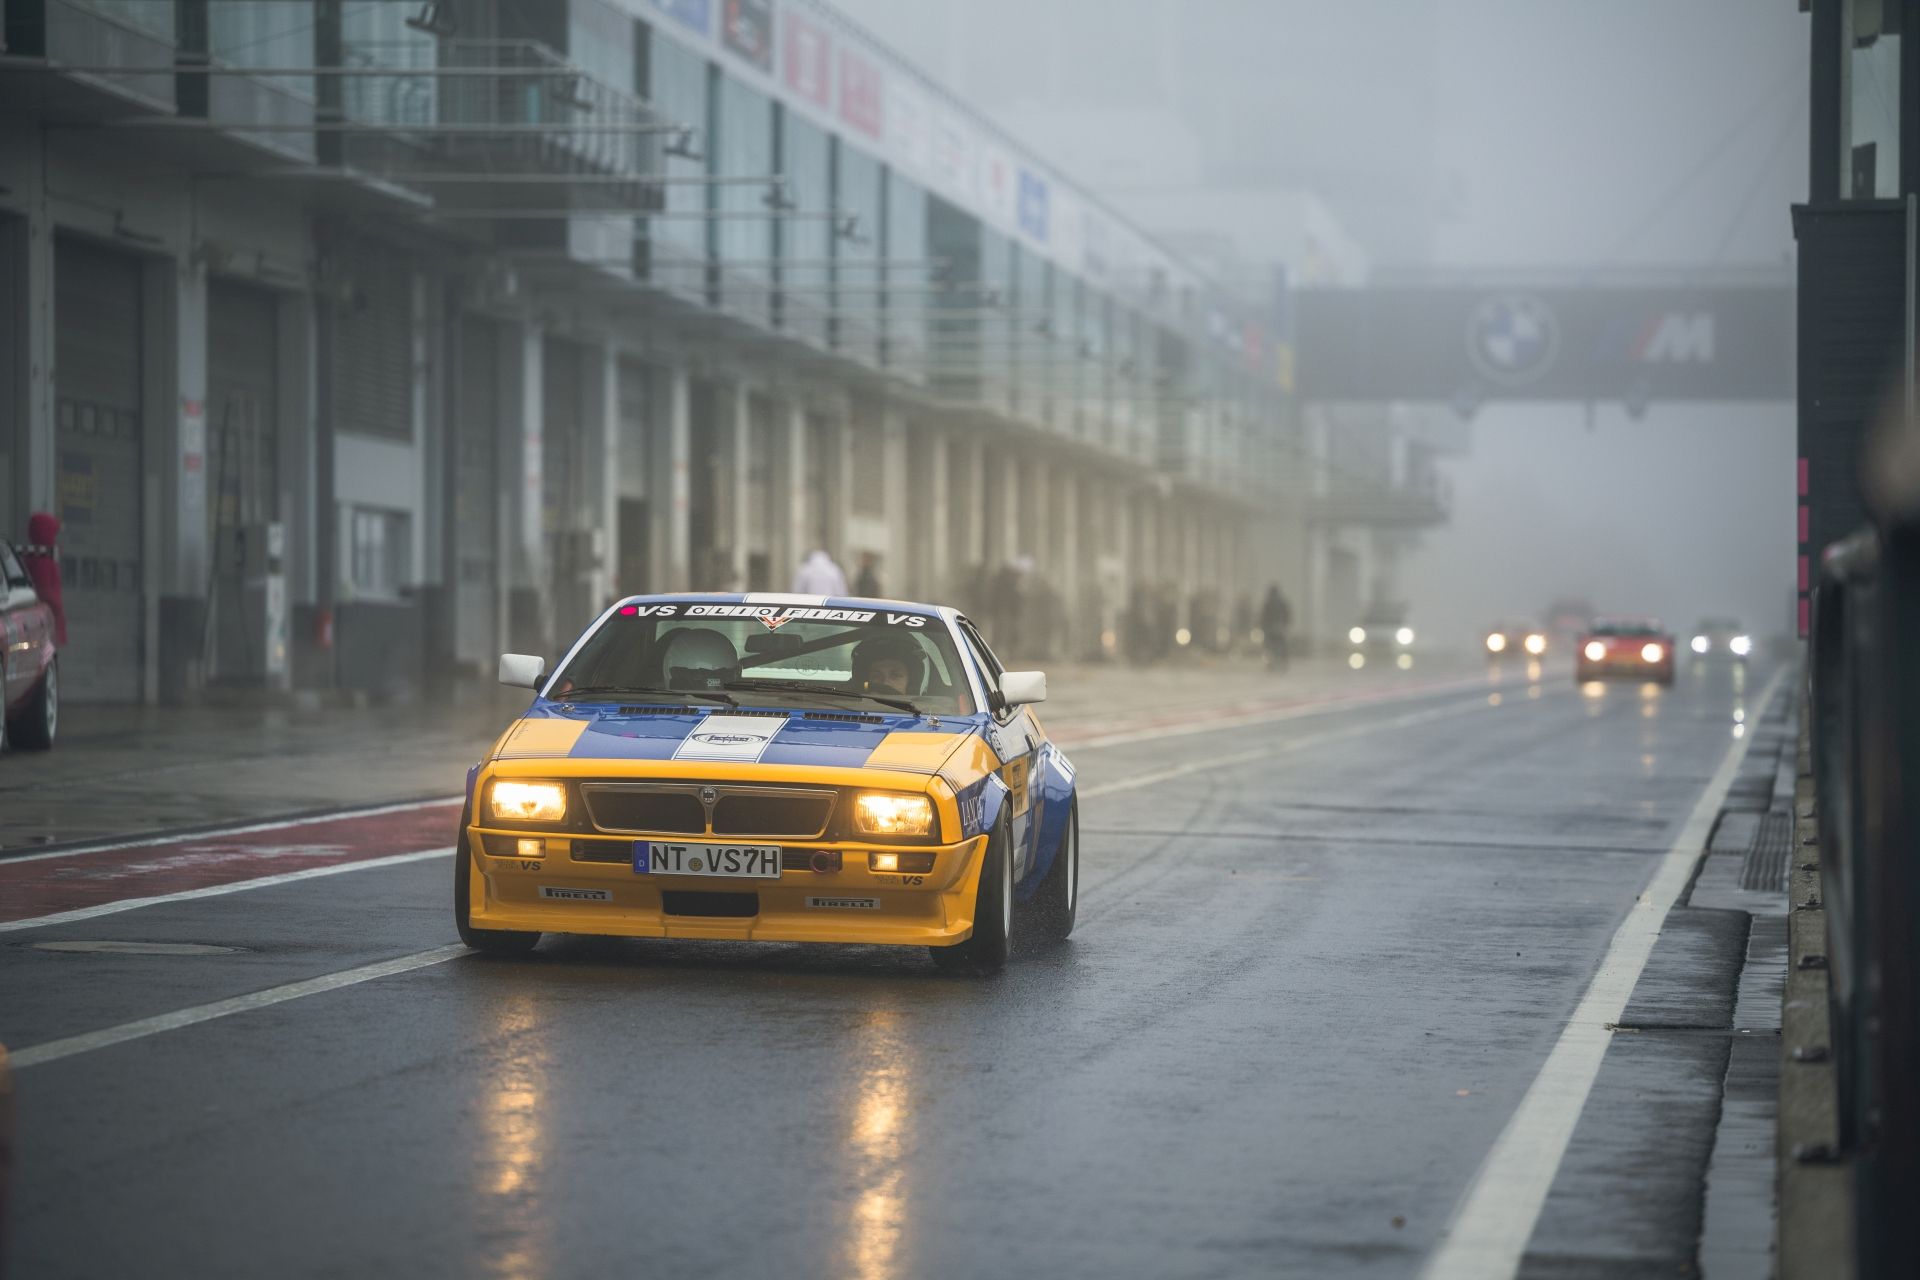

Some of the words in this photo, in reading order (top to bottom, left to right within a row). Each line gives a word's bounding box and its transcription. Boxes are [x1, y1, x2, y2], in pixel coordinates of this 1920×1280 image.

[638, 605, 678, 617] VS
[687, 605, 776, 616] OLIO
[787, 608, 873, 622] FIAT
[886, 613, 927, 627] VS
[651, 845, 687, 870] NT
[520, 861, 542, 871] VS
[902, 875, 923, 886] VS
[545, 887, 606, 900] PIRELLI
[812, 897, 874, 908] PIRELLI
